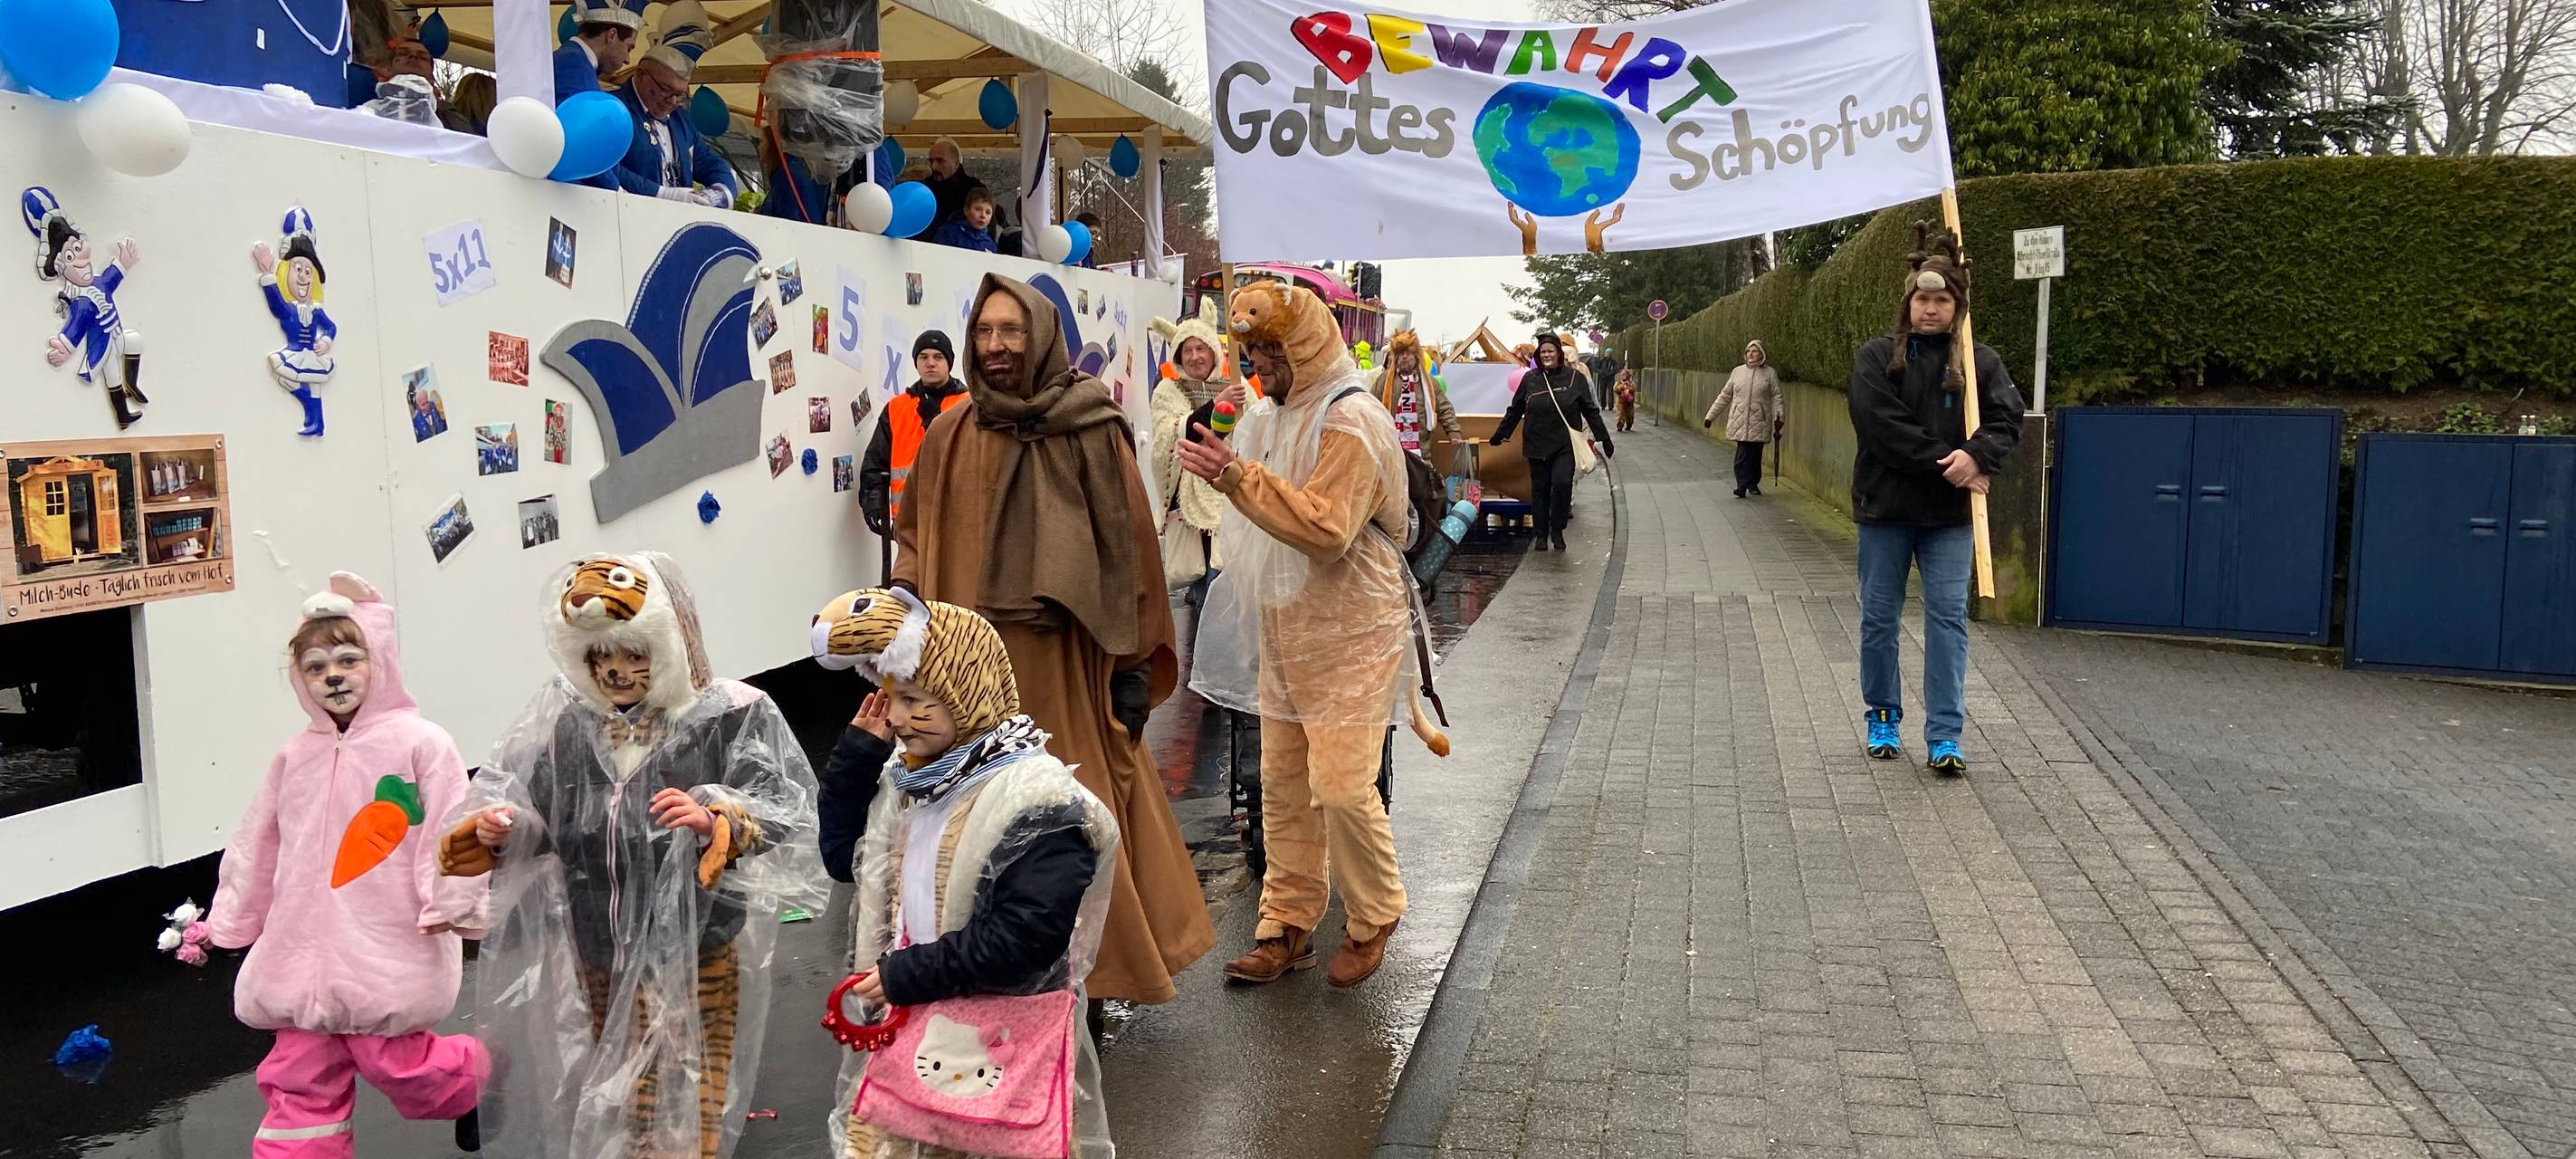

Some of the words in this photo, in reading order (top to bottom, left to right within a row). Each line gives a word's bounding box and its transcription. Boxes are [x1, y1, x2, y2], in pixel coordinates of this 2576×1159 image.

[1290, 11, 1738, 124] BEWAHRT
[1216, 61, 1455, 158] Gottes
[1666, 92, 1933, 191] Schöpfung
[429, 228, 491, 293] 5x11
[839, 285, 859, 351] 5
[20, 580, 91, 605] Milch-Bude
[143, 570, 175, 589] frisch
[178, 570, 201, 583] vom
[204, 562, 223, 580] Hof
